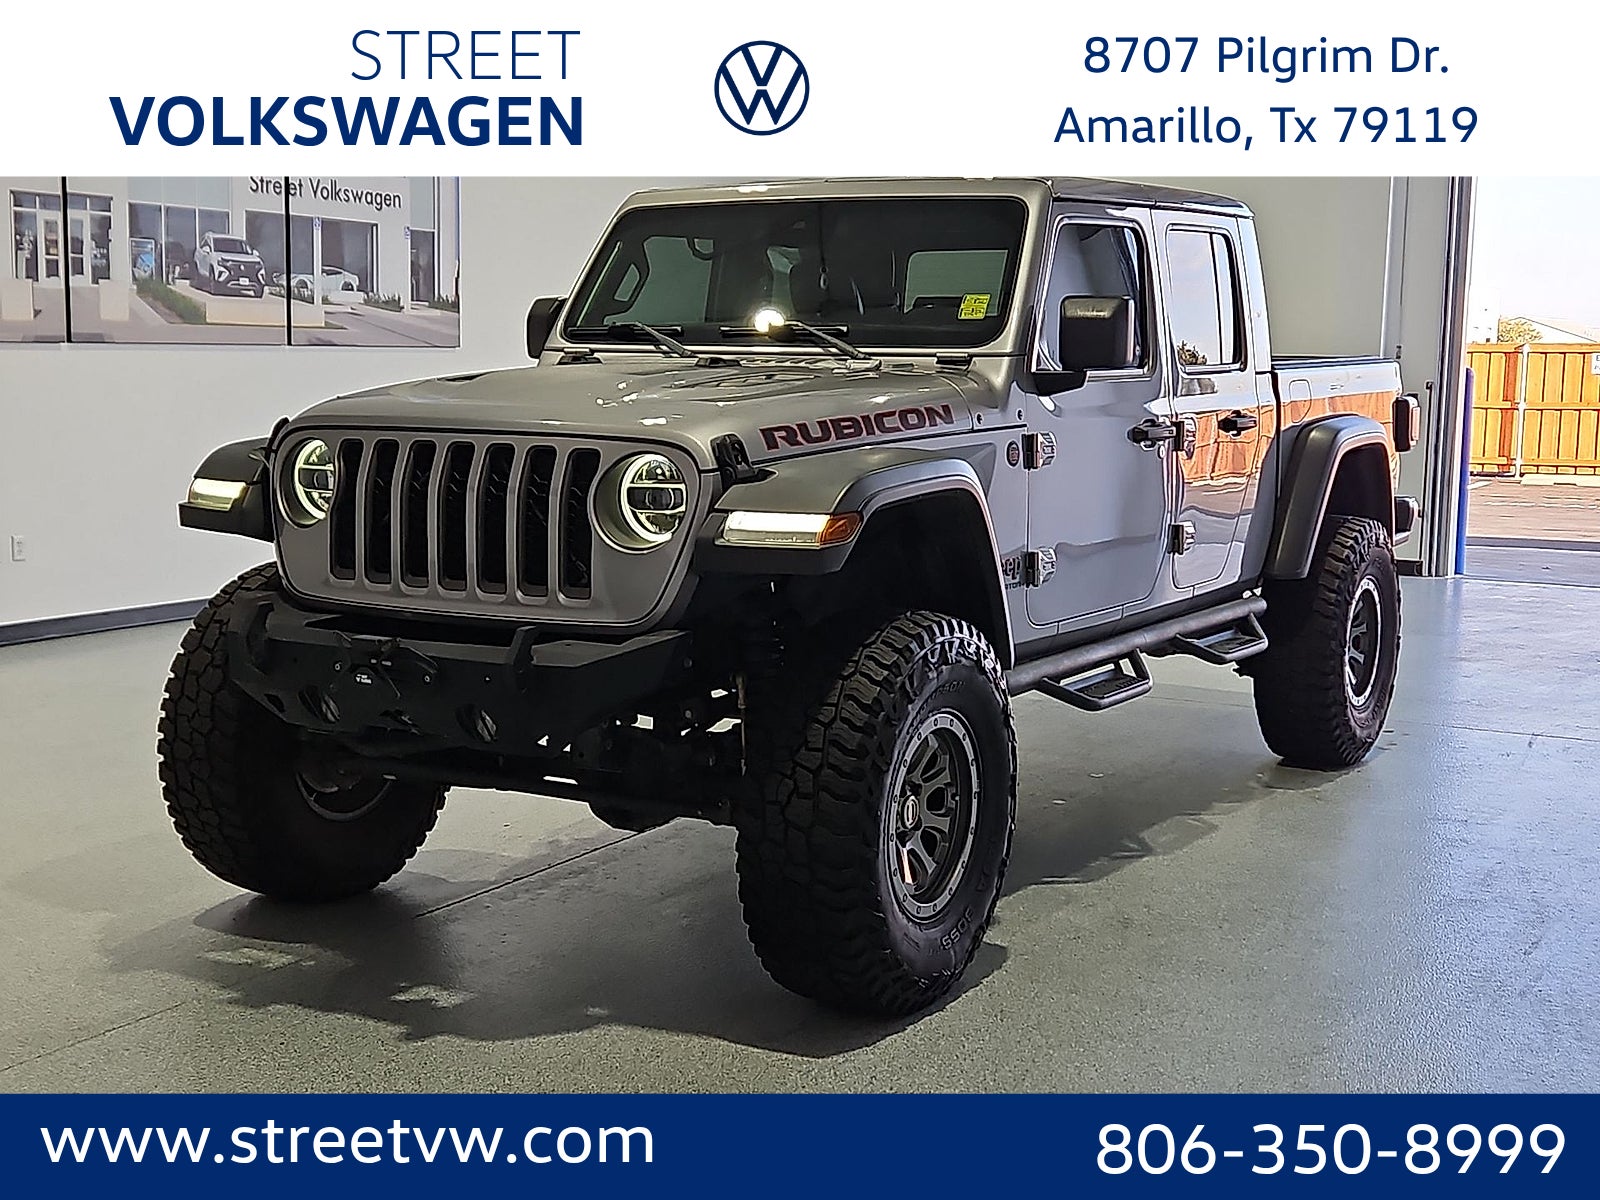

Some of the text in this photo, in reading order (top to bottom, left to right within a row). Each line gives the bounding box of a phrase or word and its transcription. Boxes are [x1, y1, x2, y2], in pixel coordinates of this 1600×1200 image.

[249, 175, 402, 212] Street Volkswagen
[758, 403, 955, 452] RUBICON
